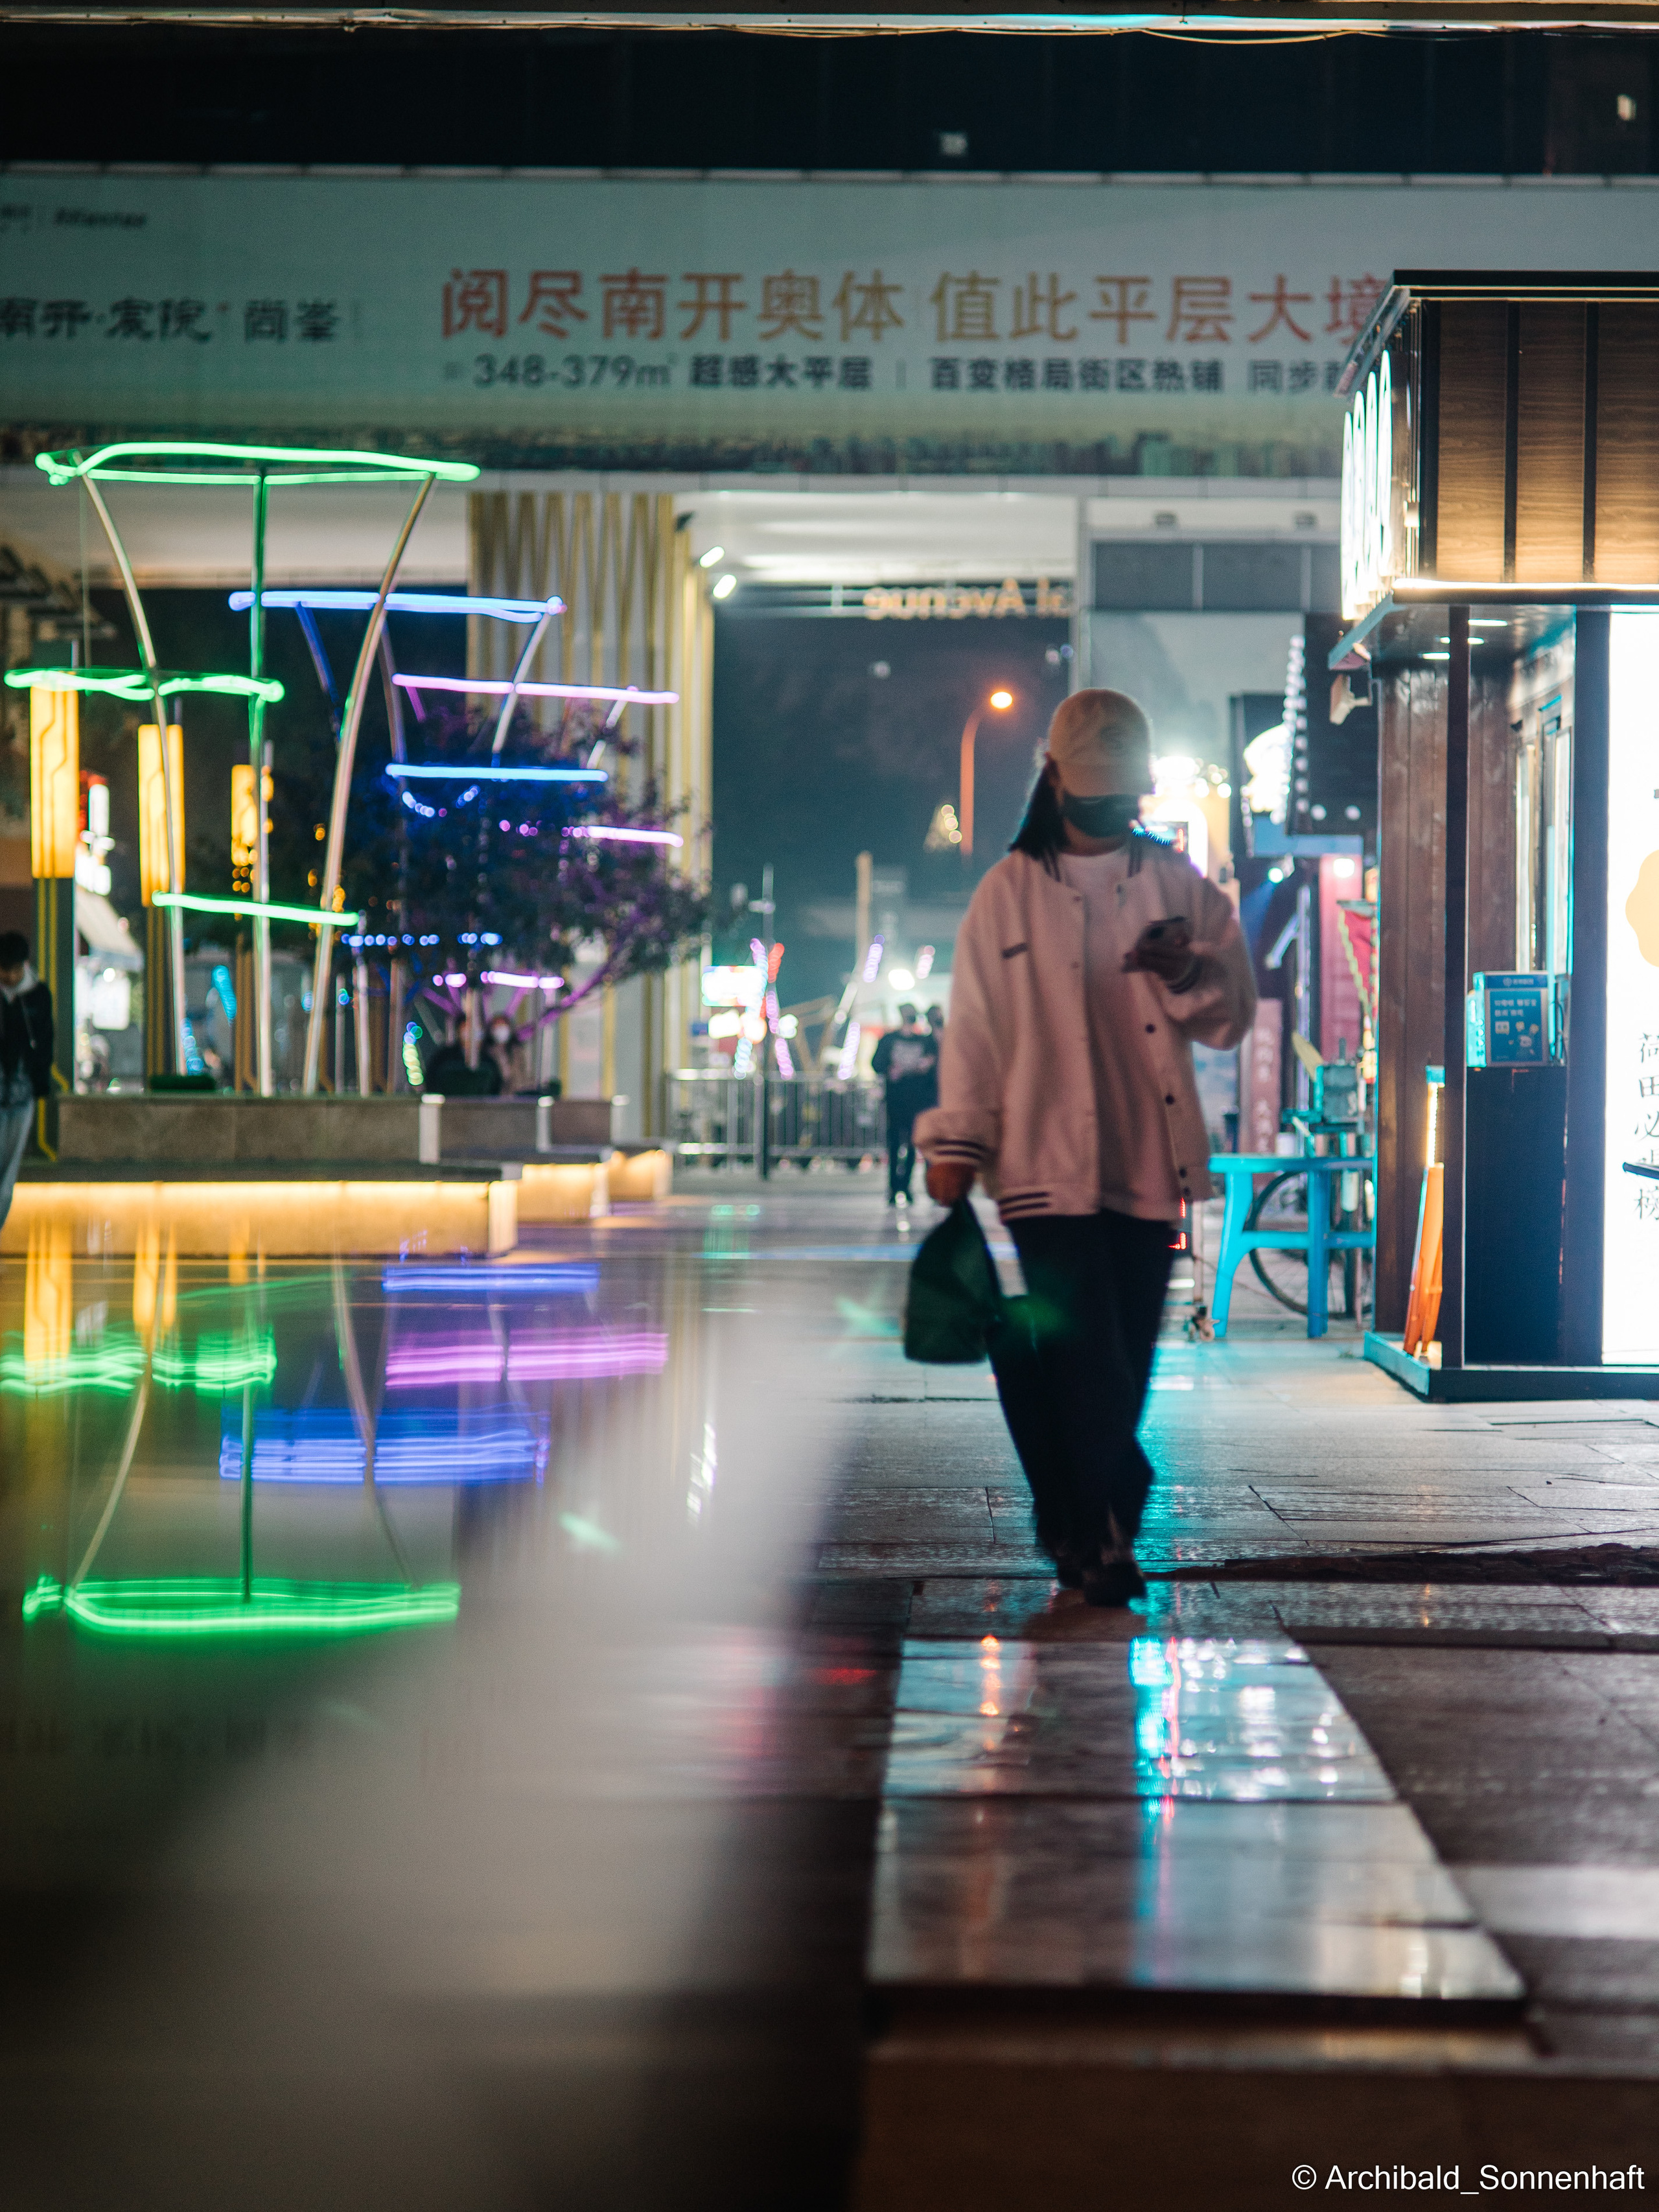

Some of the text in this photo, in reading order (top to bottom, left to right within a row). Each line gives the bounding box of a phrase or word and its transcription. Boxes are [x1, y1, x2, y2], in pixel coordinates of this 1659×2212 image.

[441, 267, 1384, 345] 阅尽南开奥体 值此平层大境
[689, 354, 874, 390] 超感大平层
